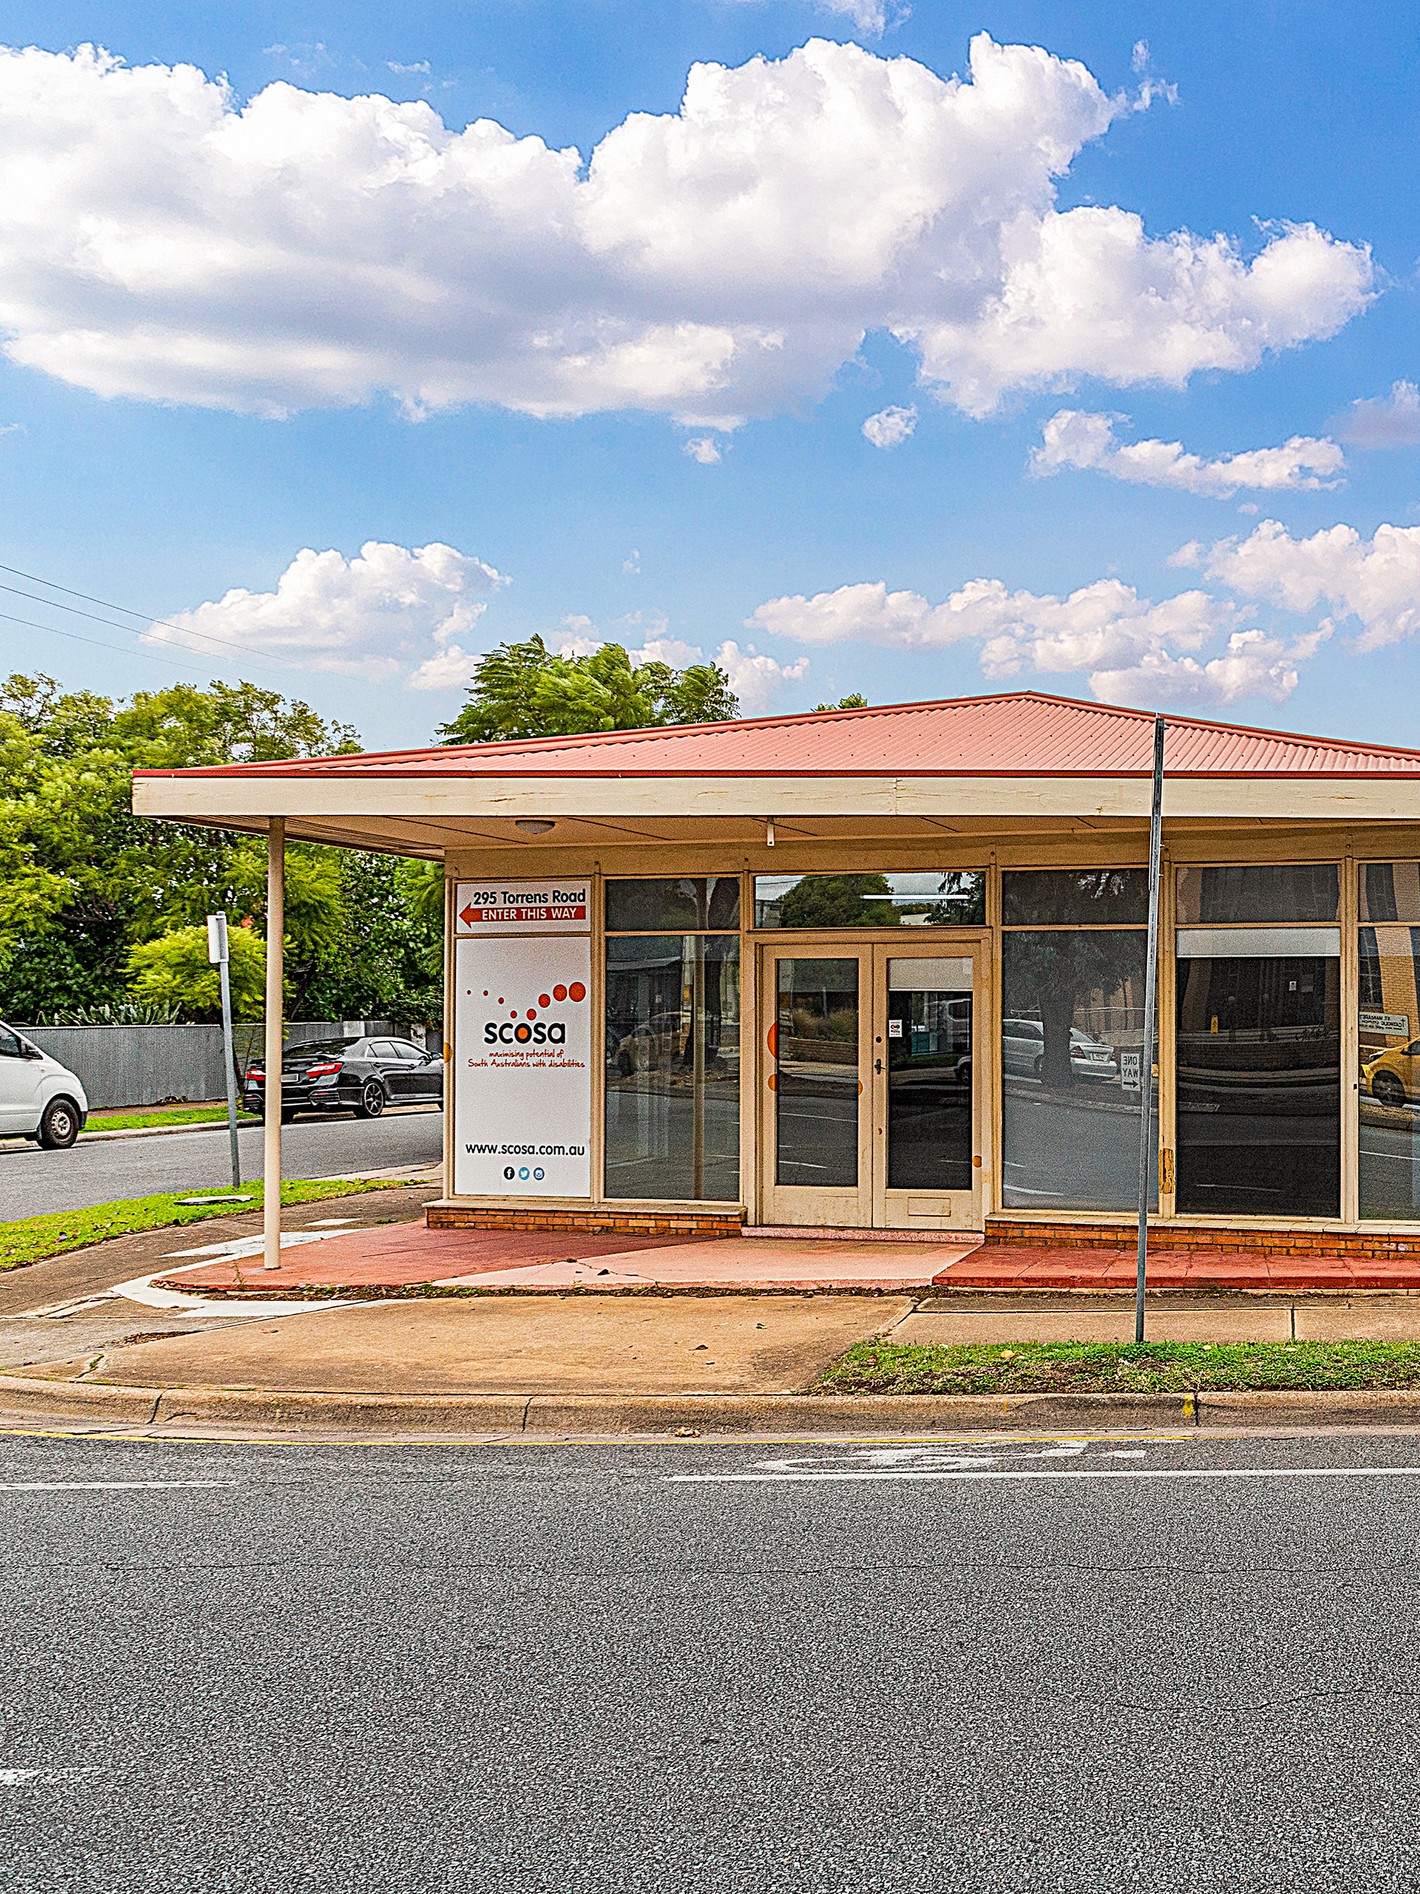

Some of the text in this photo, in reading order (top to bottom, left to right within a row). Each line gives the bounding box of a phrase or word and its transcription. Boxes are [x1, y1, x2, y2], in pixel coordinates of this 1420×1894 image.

[473, 888, 586, 905] 295 Torrens Road
[482, 907, 577, 920] ENTER THIS WAY
[483, 1022, 566, 1044] scosa
[488, 1049, 565, 1060] maximising potential of
[468, 1058, 586, 1068] South Australians with disabilities
[465, 1143, 586, 1156] www.scosa.com.au
